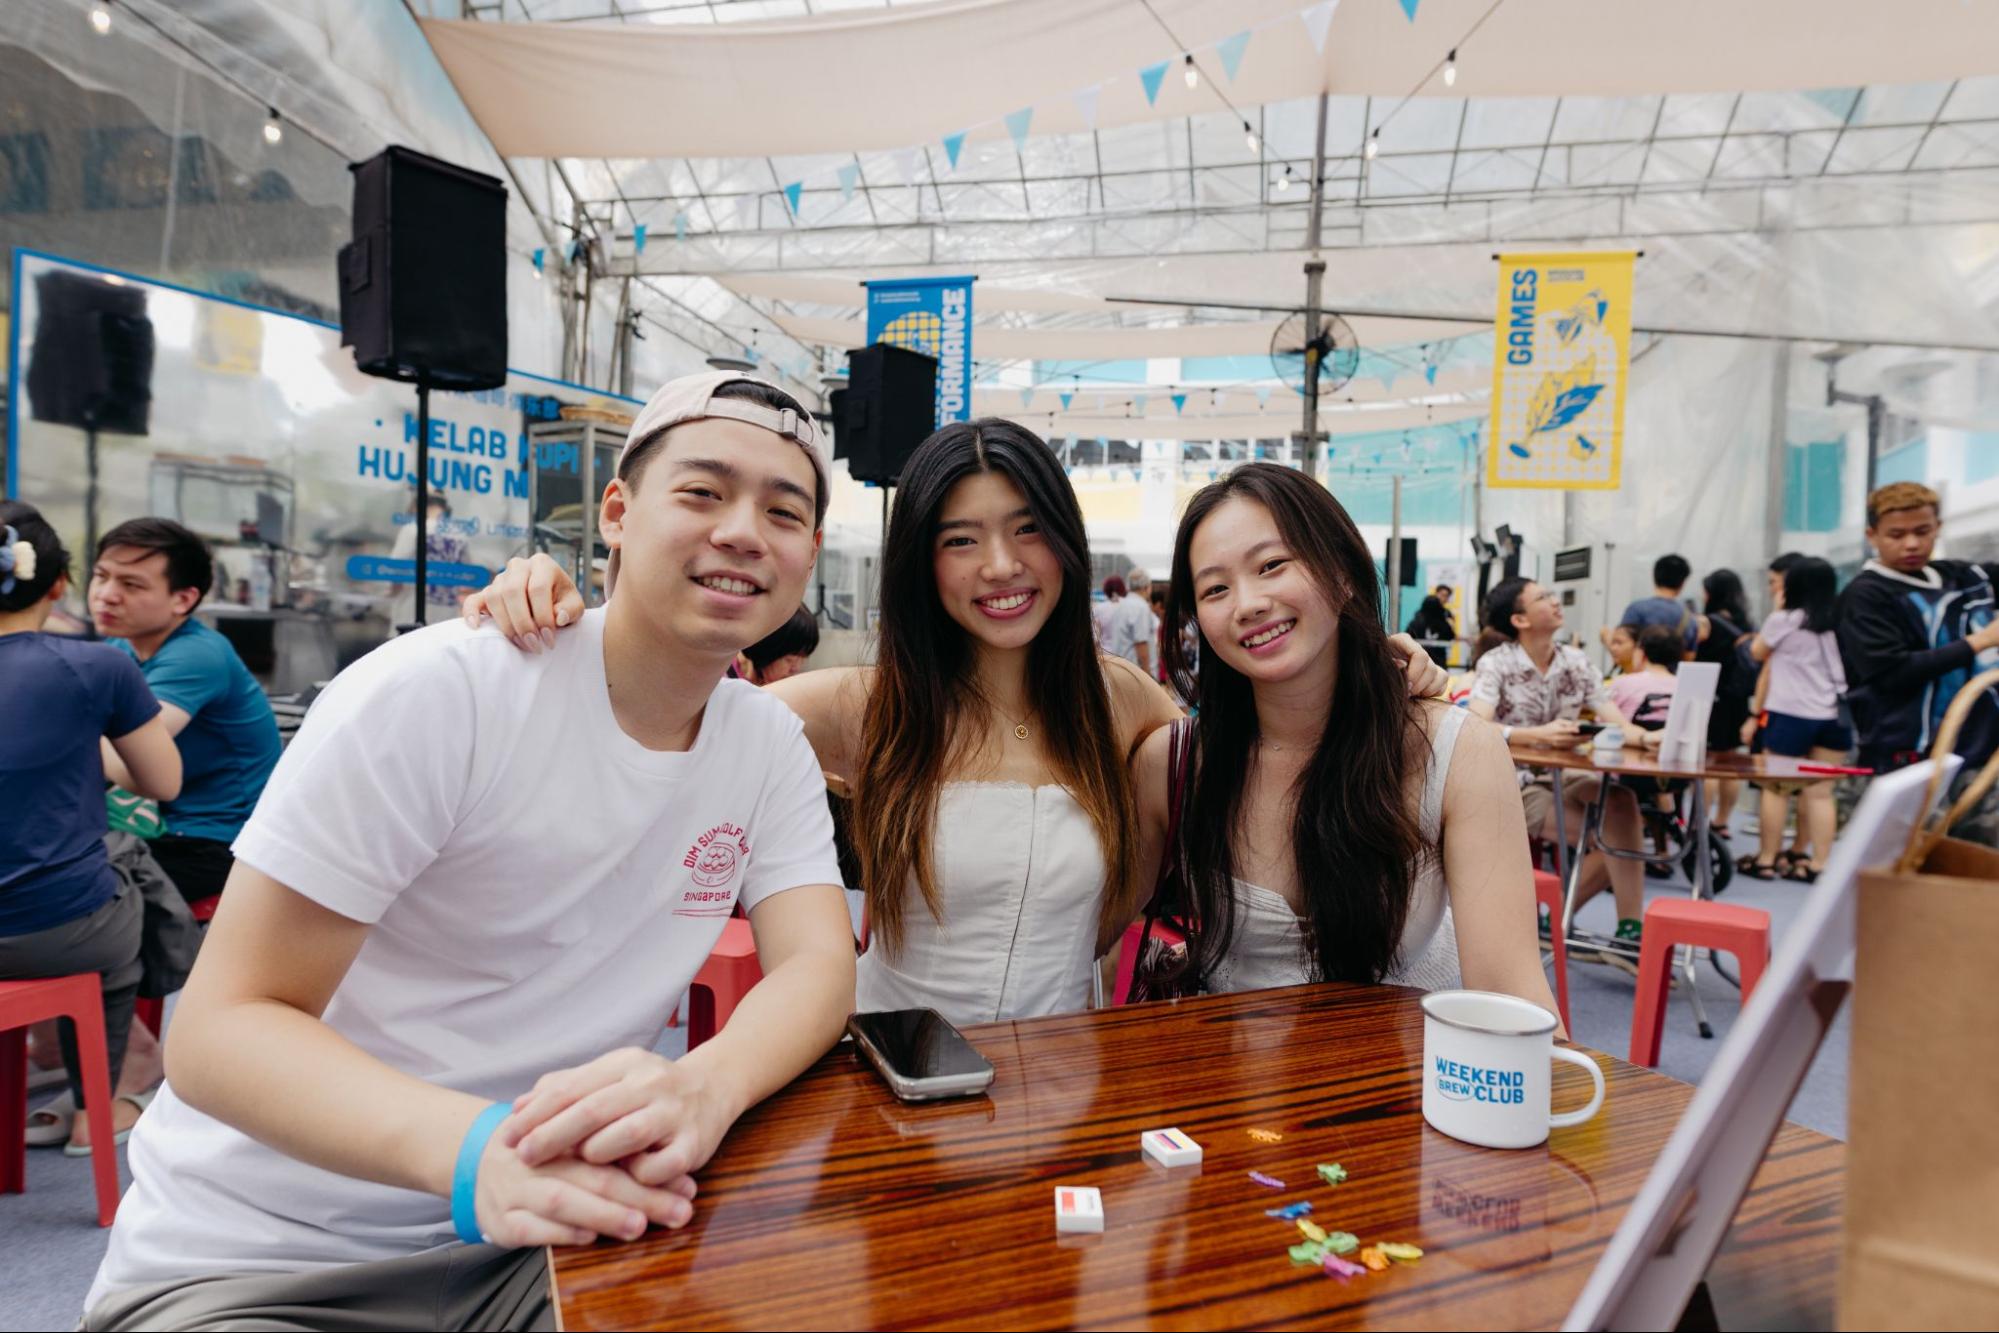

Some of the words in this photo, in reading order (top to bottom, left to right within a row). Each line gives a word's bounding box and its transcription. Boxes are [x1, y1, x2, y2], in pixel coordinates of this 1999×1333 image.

[1508, 269, 1538, 365] GAMES
[940, 288, 966, 426] FORMANCE
[683, 846, 702, 869] DIM
[1435, 1055, 1524, 1088] WEEKEND
[1438, 1078, 1471, 1096] BREW
[1474, 1085, 1524, 1105] CLUB
